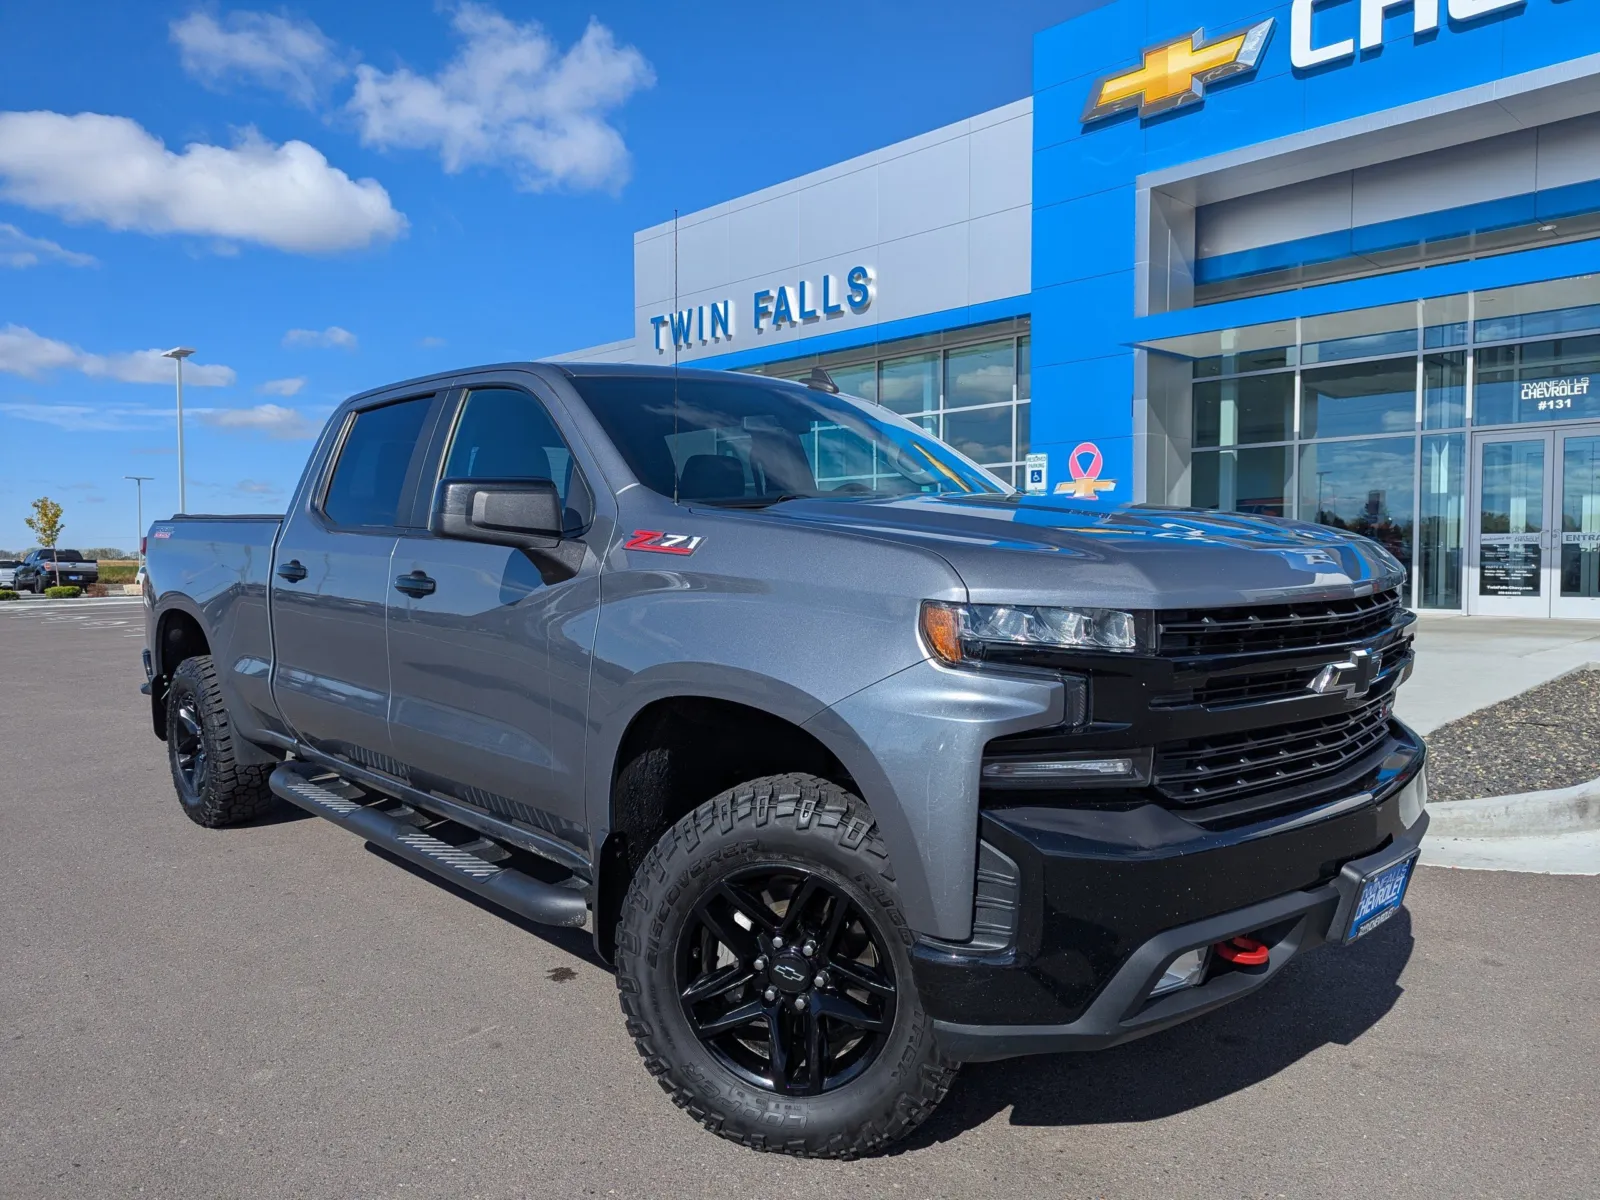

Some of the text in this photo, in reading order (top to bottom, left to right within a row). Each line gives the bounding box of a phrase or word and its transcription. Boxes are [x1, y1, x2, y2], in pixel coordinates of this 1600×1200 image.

[650, 266, 872, 352] TWIN FALLS
[1521, 383, 1589, 399] CHEVROLET
[1537, 399, 1572, 410] #131
[623, 529, 706, 556] Z71
[1353, 876, 1405, 921] CHEVROLET
